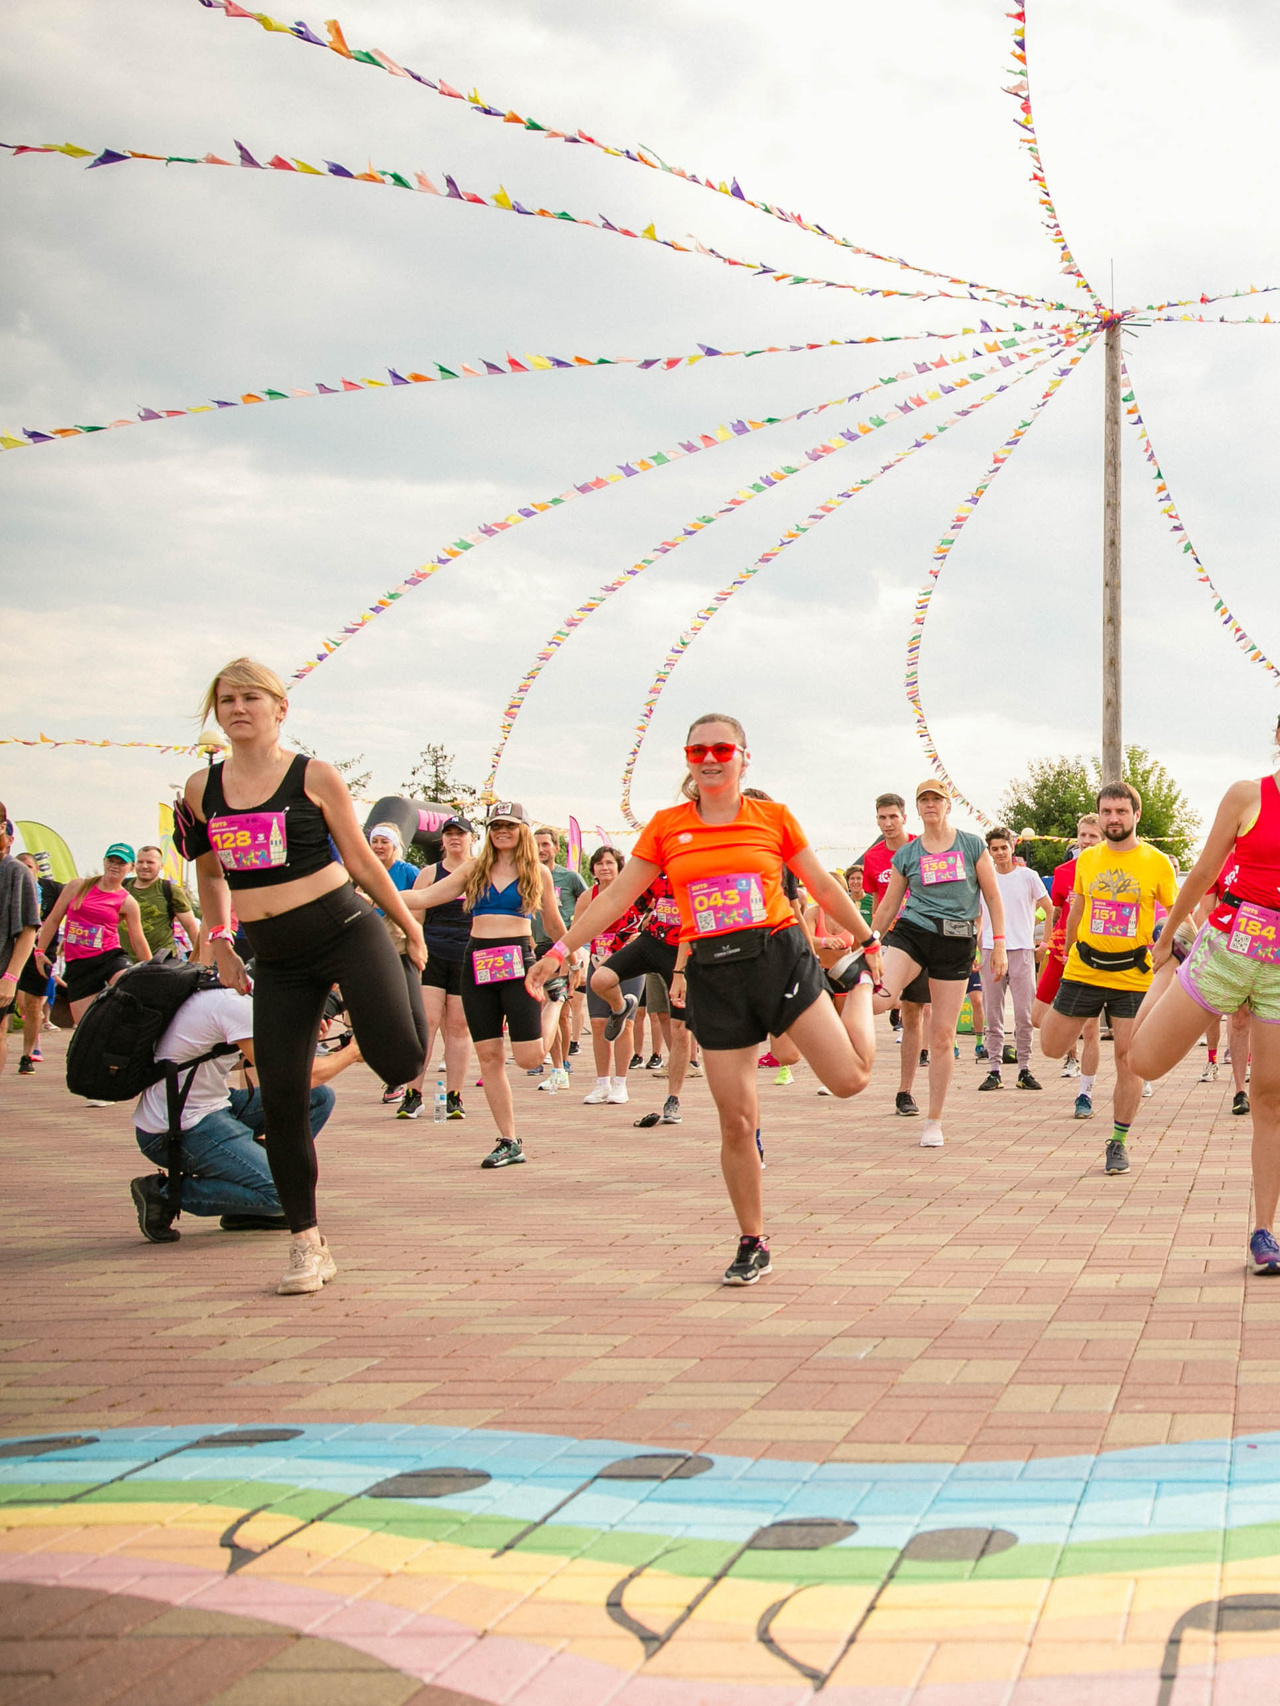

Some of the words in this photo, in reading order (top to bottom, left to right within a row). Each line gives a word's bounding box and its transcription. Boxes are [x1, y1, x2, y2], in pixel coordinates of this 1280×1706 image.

[212, 830, 252, 850] 128
[923, 861, 948, 871] 136
[694, 889, 740, 911] 043
[657, 905, 680, 915] 280
[1093, 908, 1117, 921] 151
[69, 926, 89, 937] 301
[1237, 917, 1276, 941] 184
[476, 956, 504, 970] 273
